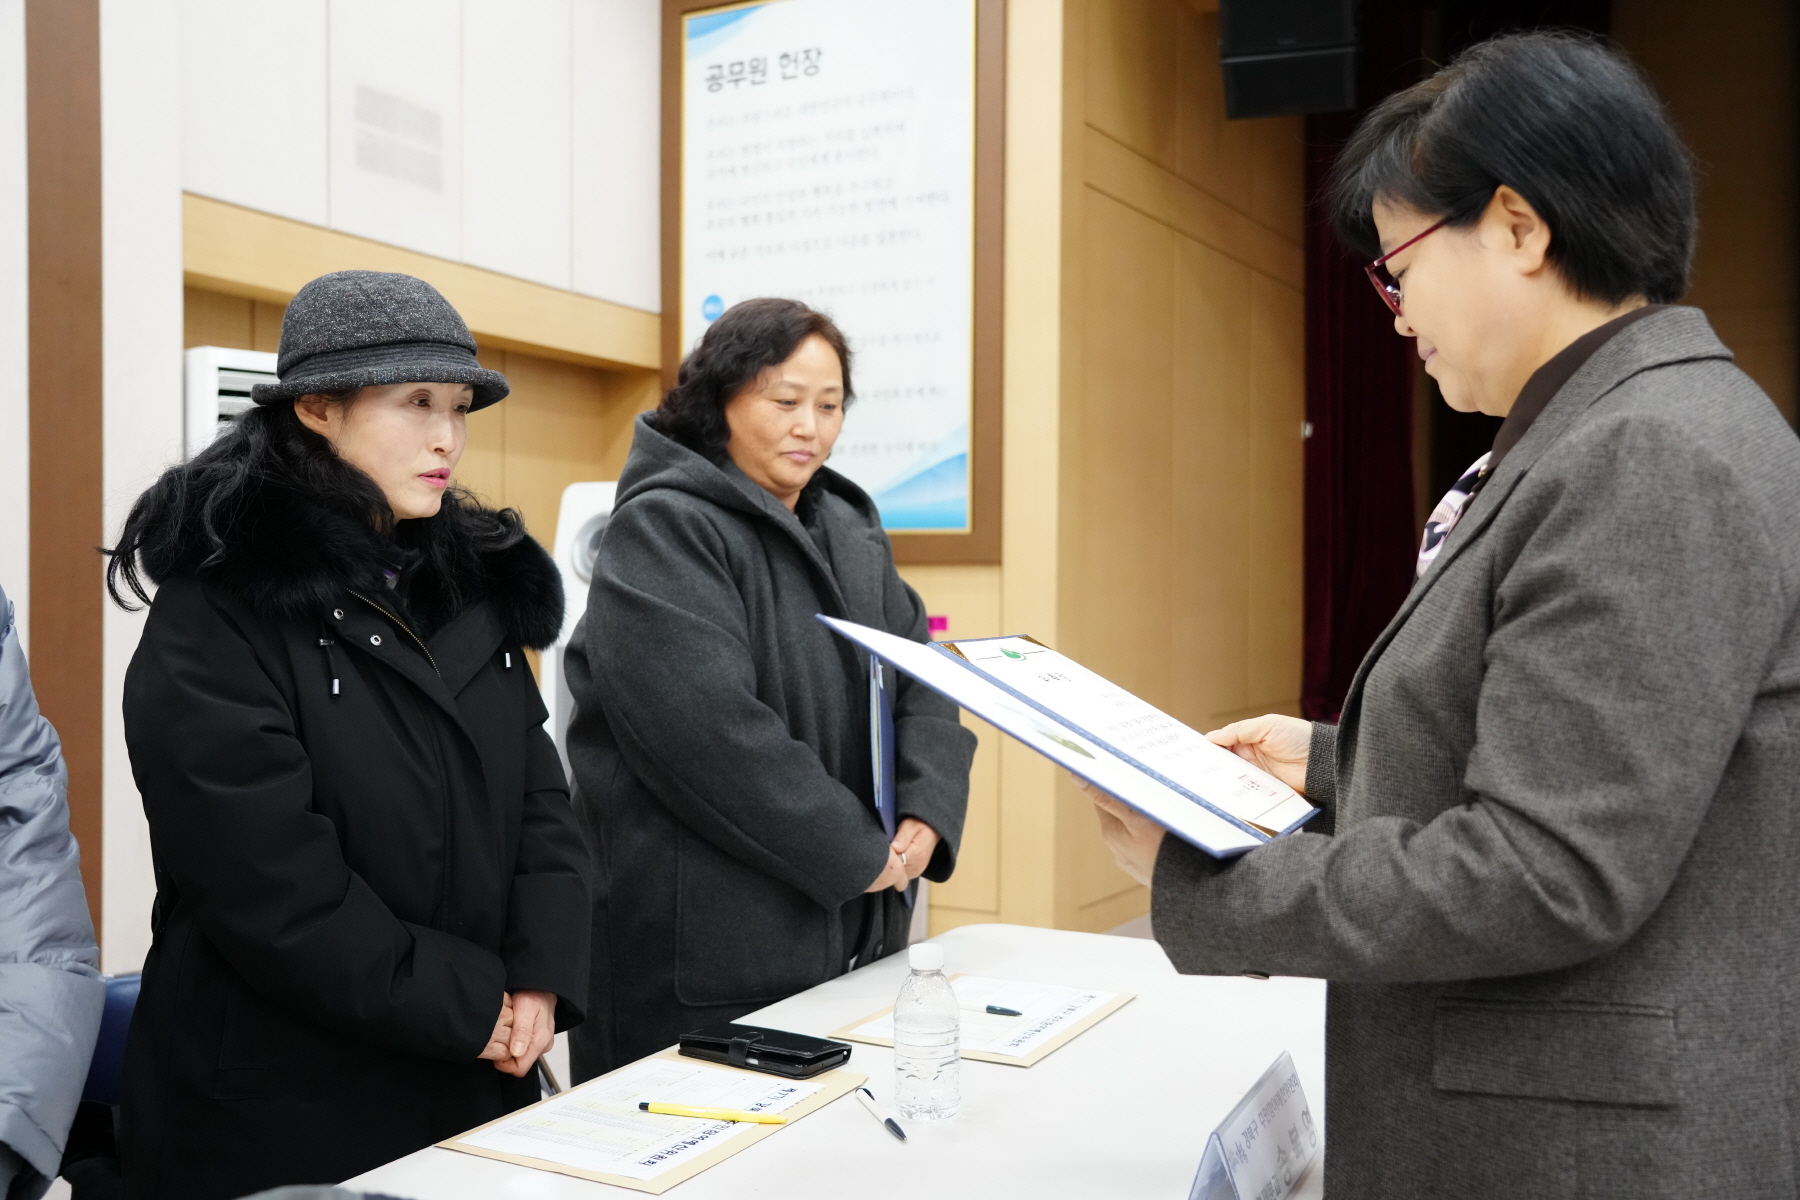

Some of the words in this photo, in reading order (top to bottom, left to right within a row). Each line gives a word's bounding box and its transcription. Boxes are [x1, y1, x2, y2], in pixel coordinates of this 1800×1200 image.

[705, 57, 768, 93] 공무원
[779, 48, 823, 81] 헌장
[1241, 1121, 1260, 1149] 강북구
